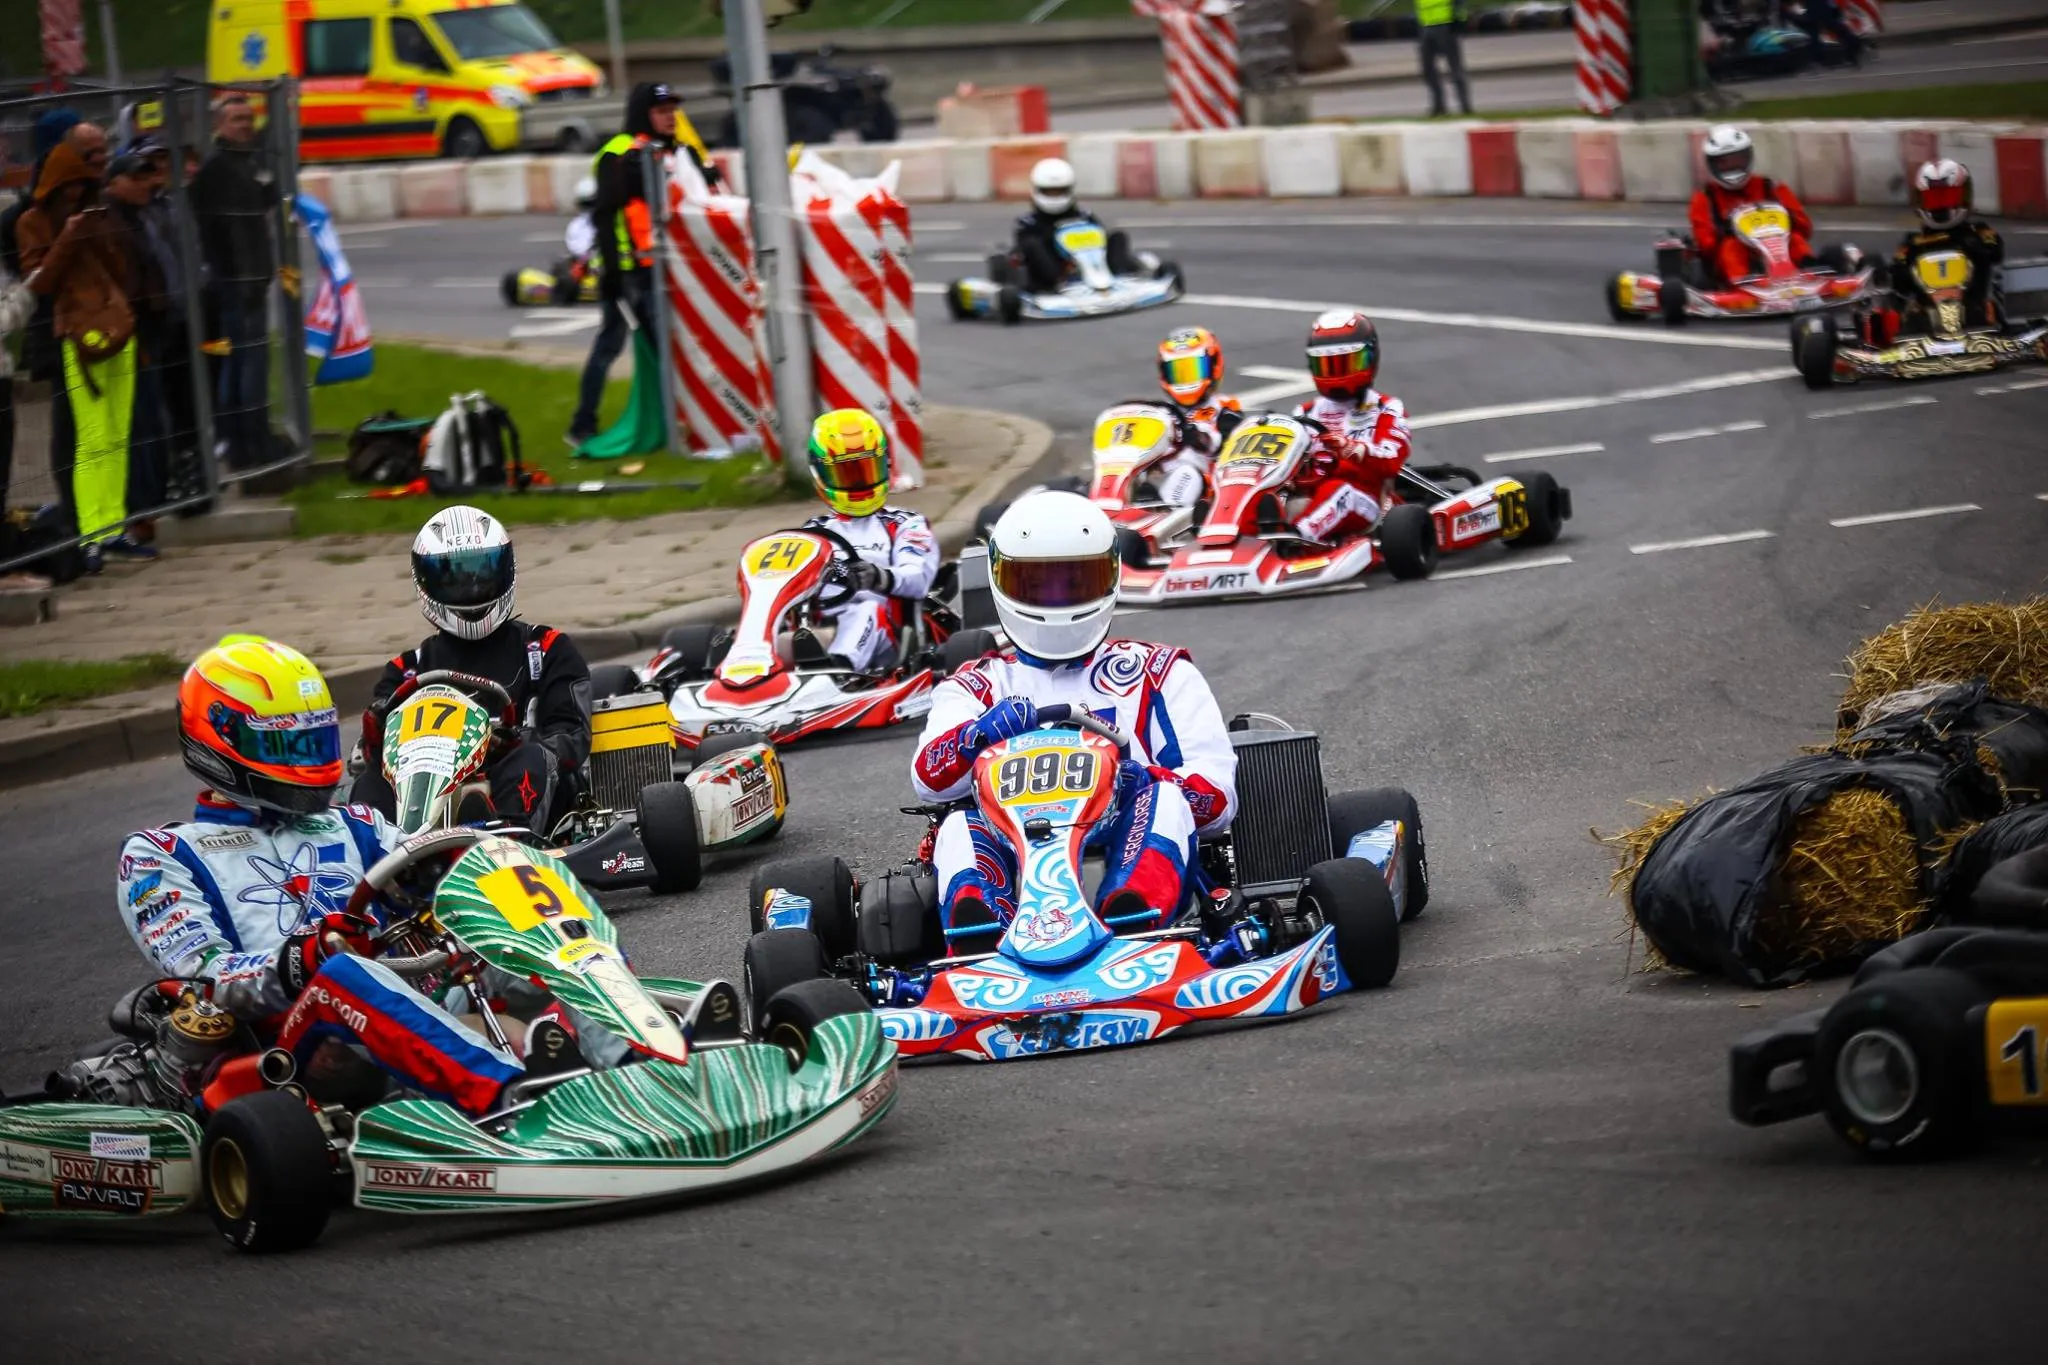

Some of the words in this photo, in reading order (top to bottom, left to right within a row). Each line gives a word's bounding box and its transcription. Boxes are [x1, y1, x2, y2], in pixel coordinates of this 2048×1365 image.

[1229, 432, 1294, 458] 105
[759, 541, 803, 570] 24
[413, 702, 458, 733] 17
[999, 751, 1097, 802] 999
[512, 865, 563, 918] 5
[369, 1166, 424, 1185] TONY
[436, 1169, 494, 1188] KART
